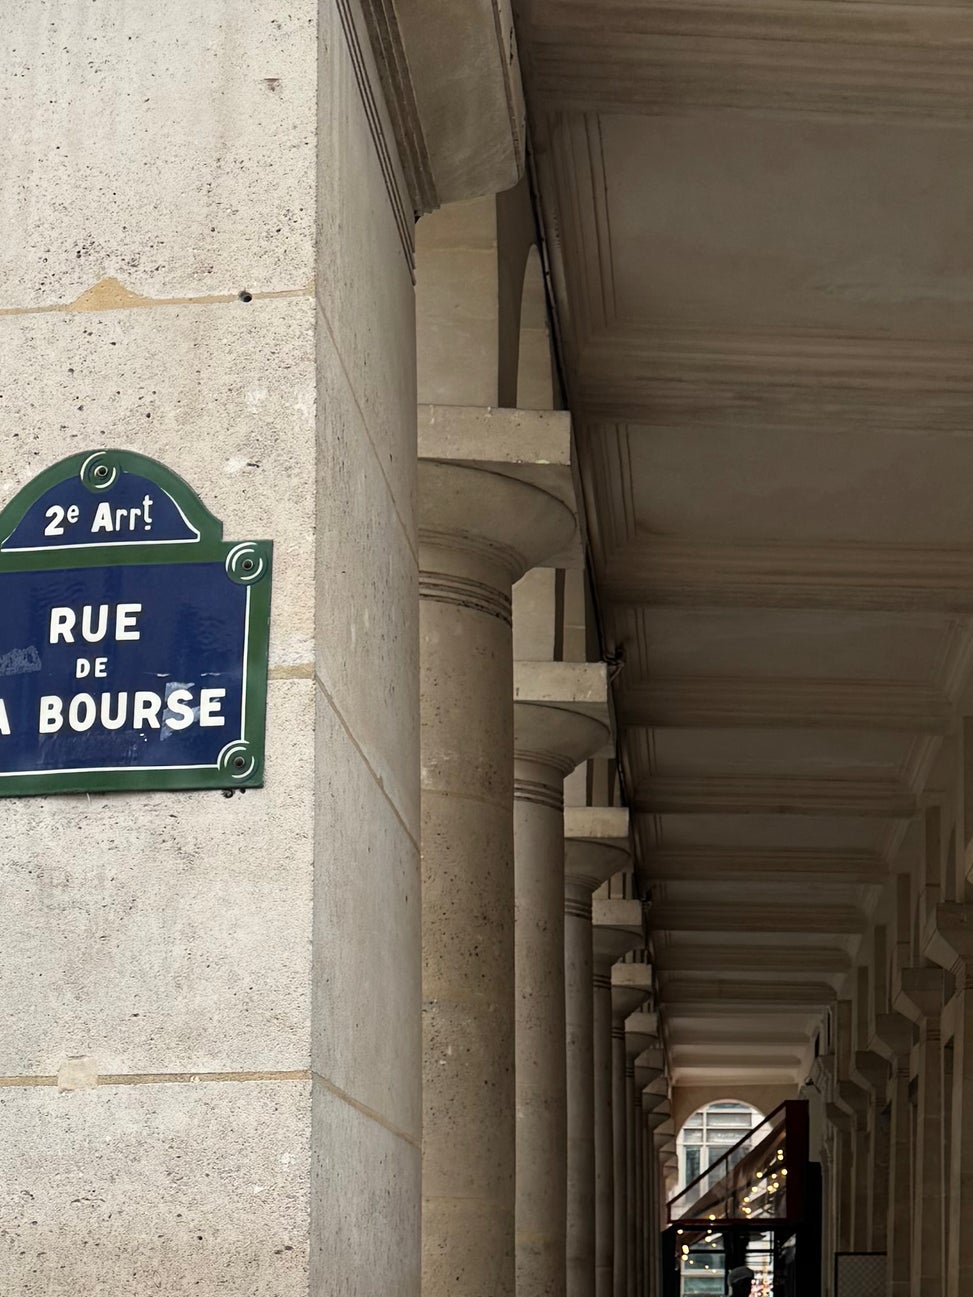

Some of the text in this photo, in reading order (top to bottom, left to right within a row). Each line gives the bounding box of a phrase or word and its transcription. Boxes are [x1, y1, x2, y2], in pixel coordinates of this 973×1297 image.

[49, 603, 142, 644] RUE
[75, 657, 108, 679] DE
[38, 687, 226, 734] BOURSE
